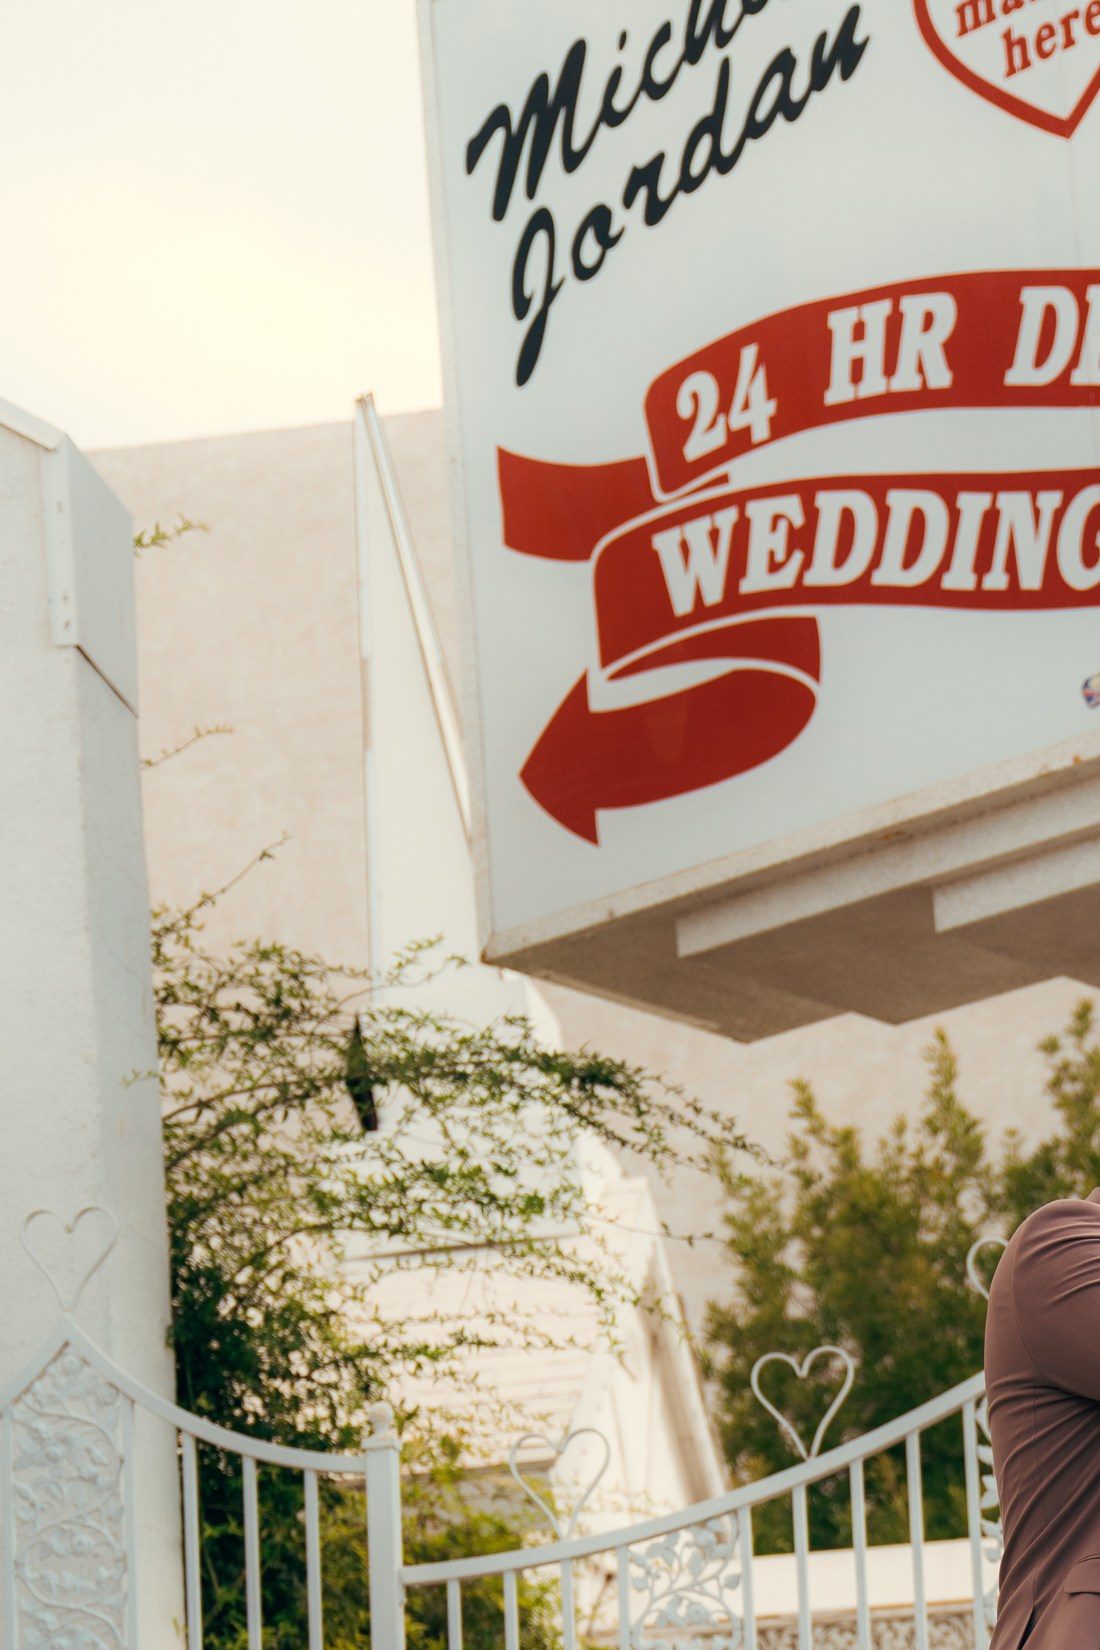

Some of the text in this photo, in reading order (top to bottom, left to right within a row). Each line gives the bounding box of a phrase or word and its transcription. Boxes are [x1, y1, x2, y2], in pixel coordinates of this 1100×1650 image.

[512, 4, 870, 387] Jordan
[676, 343, 777, 462] 24
[823, 291, 957, 406] HR
